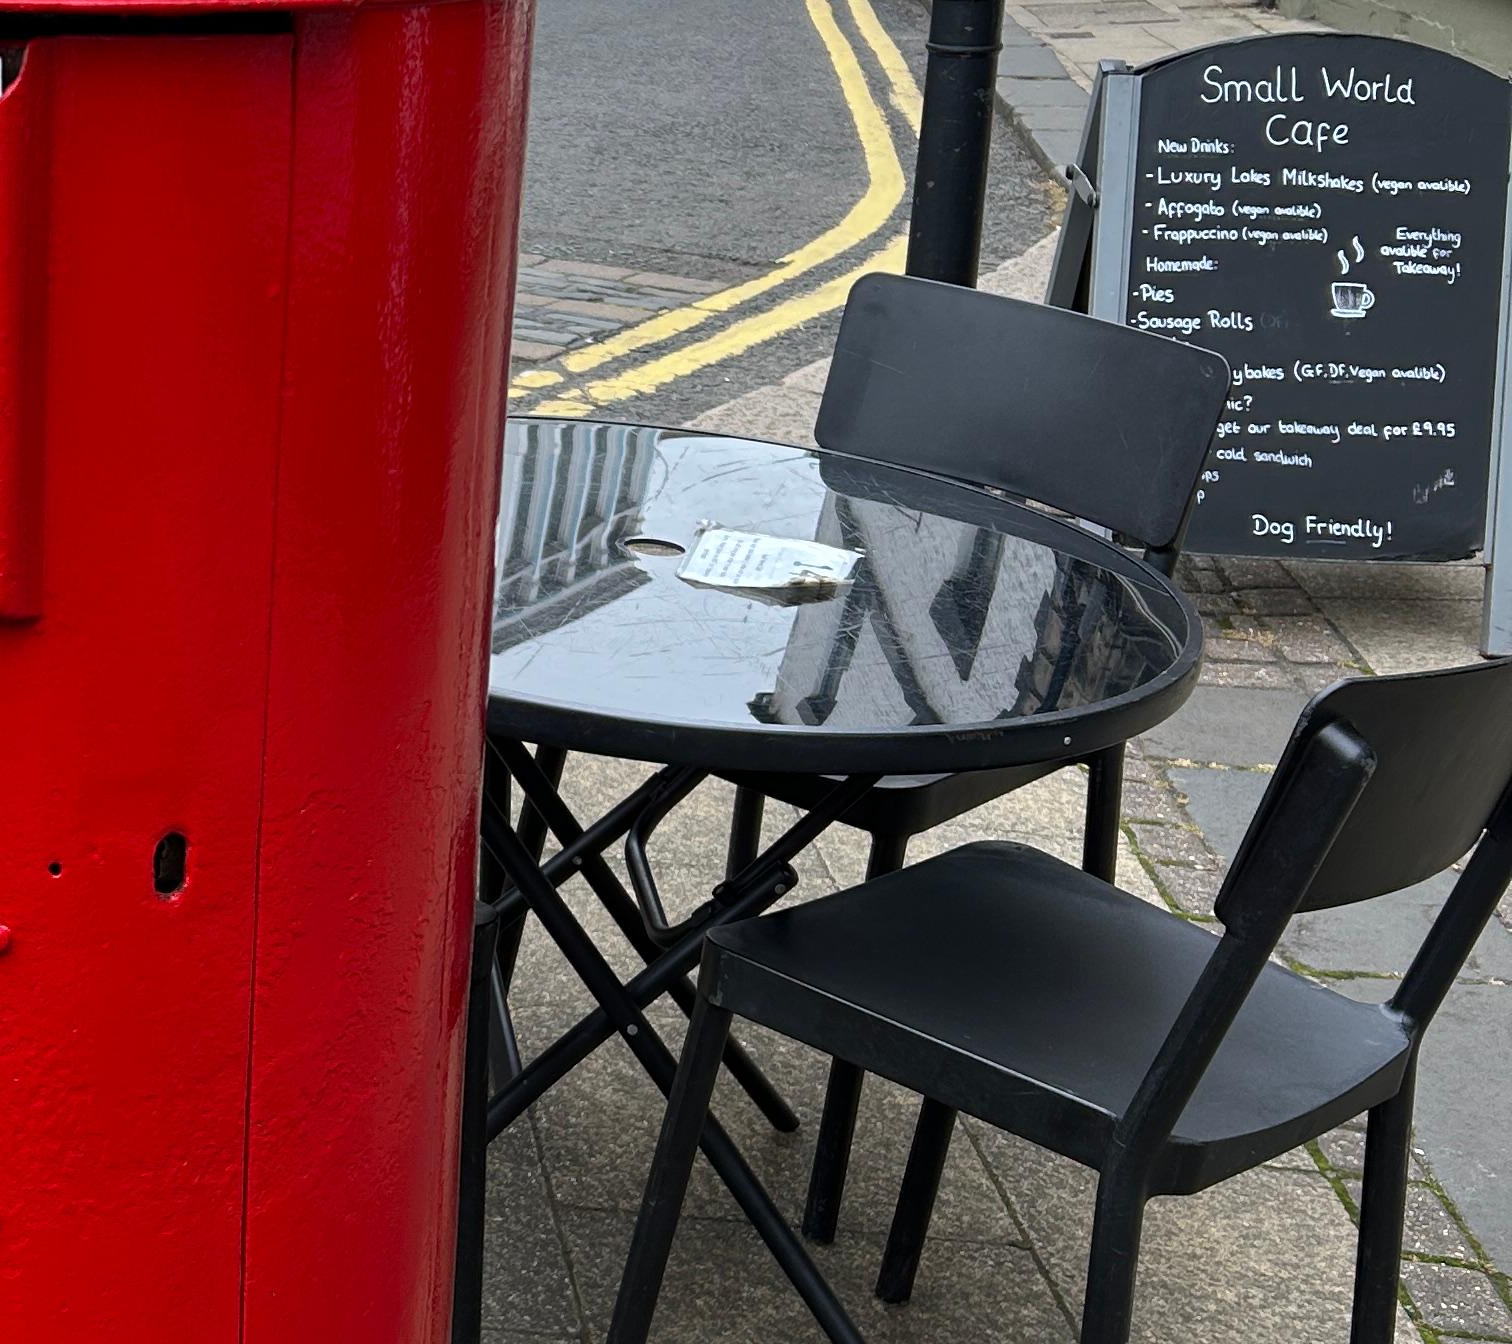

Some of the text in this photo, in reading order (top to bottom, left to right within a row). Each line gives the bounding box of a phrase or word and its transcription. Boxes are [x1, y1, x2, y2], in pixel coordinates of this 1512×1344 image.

[1200, 65, 1415, 105] Small World
[1266, 114, 1349, 153] Cafe
[1158, 137, 1235, 154] New Drinks:
[1232, 167, 1271, 186] Lakes
[1283, 168, 1364, 193] Milkshakes
[1372, 172, 1412, 195] (vegan
[1158, 198, 1225, 221] Affogato
[1232, 200, 1270, 220] (vegan
[1154, 224, 1238, 245] Frappuccino
[1242, 226, 1279, 246] (vegan
[1396, 226, 1462, 248] Everything
[1146, 256, 1219, 273] Homemade:
[1432, 248, 1453, 260] for
[1393, 260, 1461, 285] Takeaway!
[1207, 309, 1254, 332] Rolls
[1217, 420, 1456, 443] get our takeaway deal for £9.95
[1216, 448, 1312, 467] cold sandwich
[1252, 514, 1392, 548] Dog Friendly!
